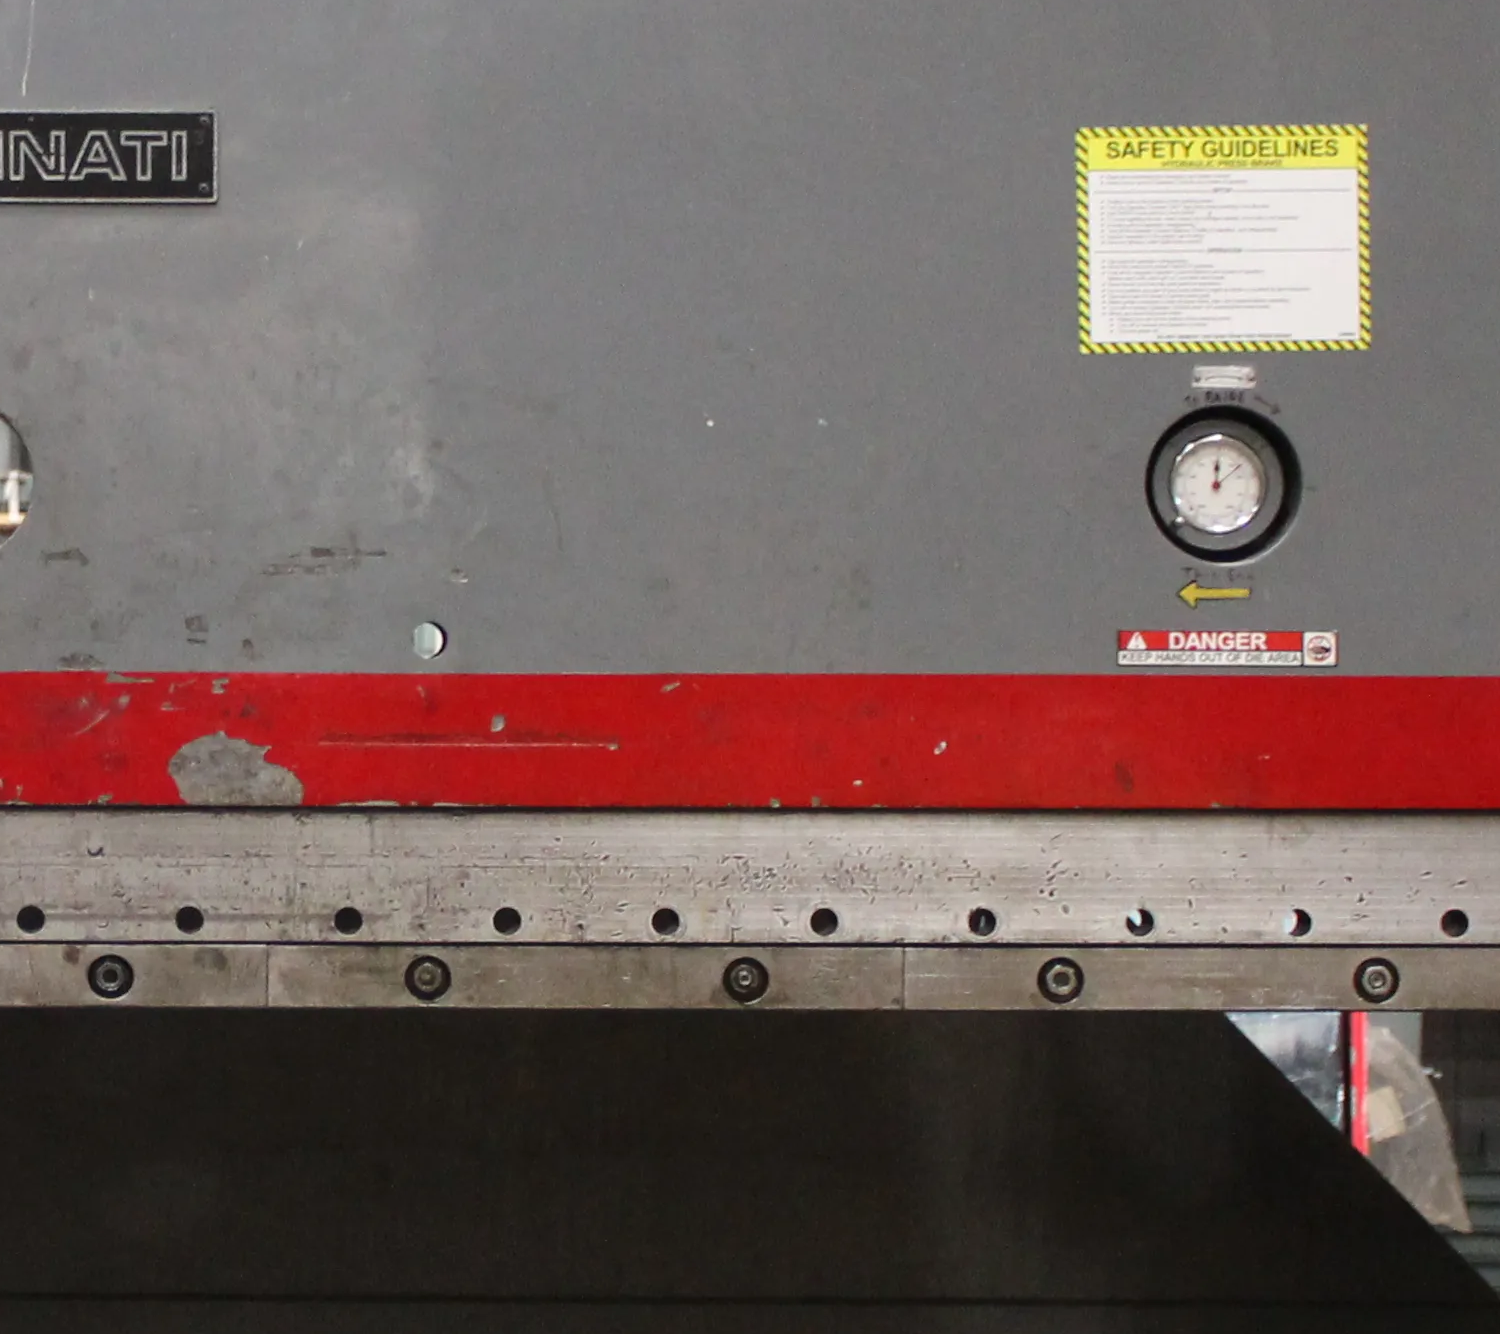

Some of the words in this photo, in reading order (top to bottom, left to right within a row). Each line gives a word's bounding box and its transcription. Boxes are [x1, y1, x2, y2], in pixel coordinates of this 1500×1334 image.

[1106, 140, 1195, 159] SAFETY
[1201, 139, 1339, 158] GUIDELINES
[1168, 632, 1268, 650] DANGER
[1120, 652, 1153, 663] KEEP
[1156, 652, 1196, 663] HANDS
[1199, 652, 1222, 663] OUT
[1225, 652, 1241, 663] OF
[1245, 652, 1264, 663] DIE
[1267, 652, 1300, 663] AREA
